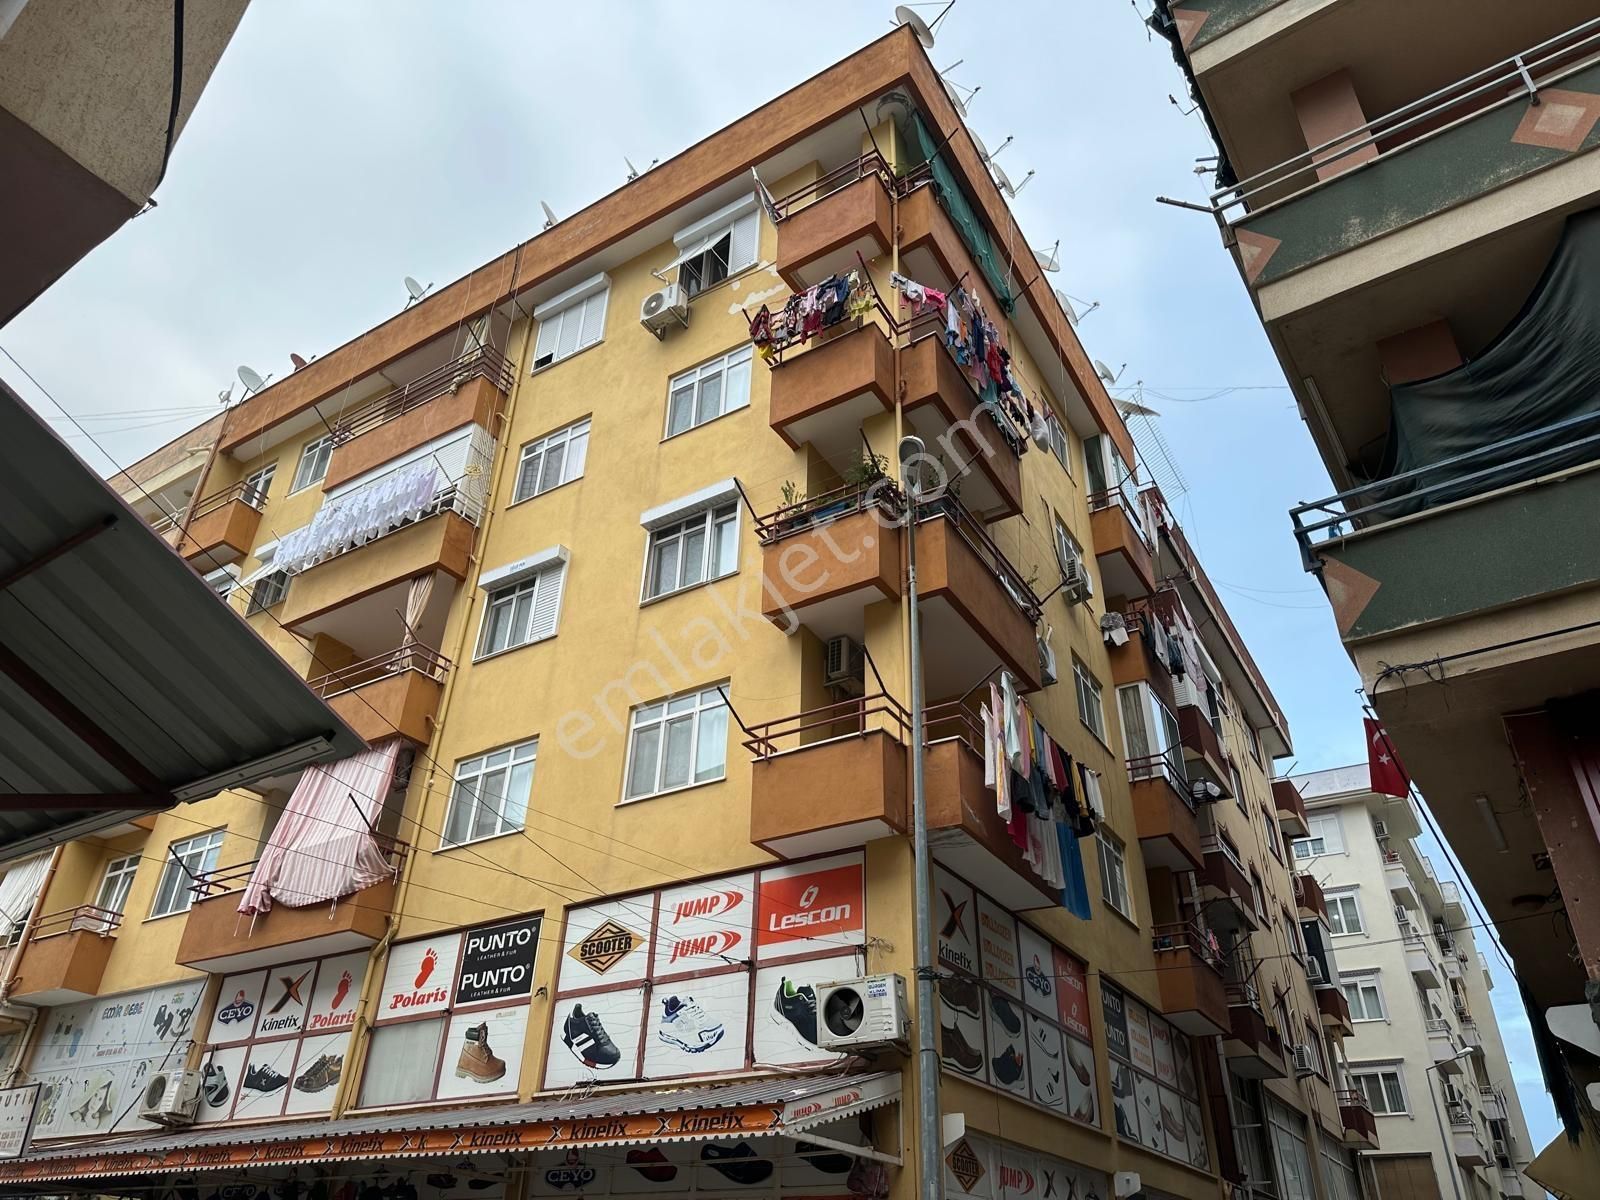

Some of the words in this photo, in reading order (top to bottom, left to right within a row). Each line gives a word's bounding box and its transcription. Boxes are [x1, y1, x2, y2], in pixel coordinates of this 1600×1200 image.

[673, 895, 721, 925] JUMP
[769, 904, 851, 932] Lescon
[467, 928, 532, 955] PUNTO
[580, 935, 633, 957] SCOOTER
[669, 935, 718, 964] JUMP
[939, 940, 972, 971] kinetix
[461, 964, 526, 991] PUNTO
[1025, 970, 1051, 993] CEYO
[1058, 965, 1084, 993] Lescon
[390, 986, 448, 1010] Polaris
[219, 1005, 253, 1020] CEYO
[261, 1014, 300, 1032] kinetix
[309, 1009, 357, 1029] Polaris
[1063, 1012, 1089, 1038] Lescon
[569, 1120, 628, 1140] kinetix
[680, 1112, 746, 1133] kinetix
[340, 1136, 385, 1153] kinetix
[469, 1129, 524, 1147] kinetix
[195, 1150, 232, 1164] kinetix
[264, 1144, 306, 1160] kinetix
[547, 1168, 594, 1182] CEYO
[999, 1163, 1023, 1191] JUMP
